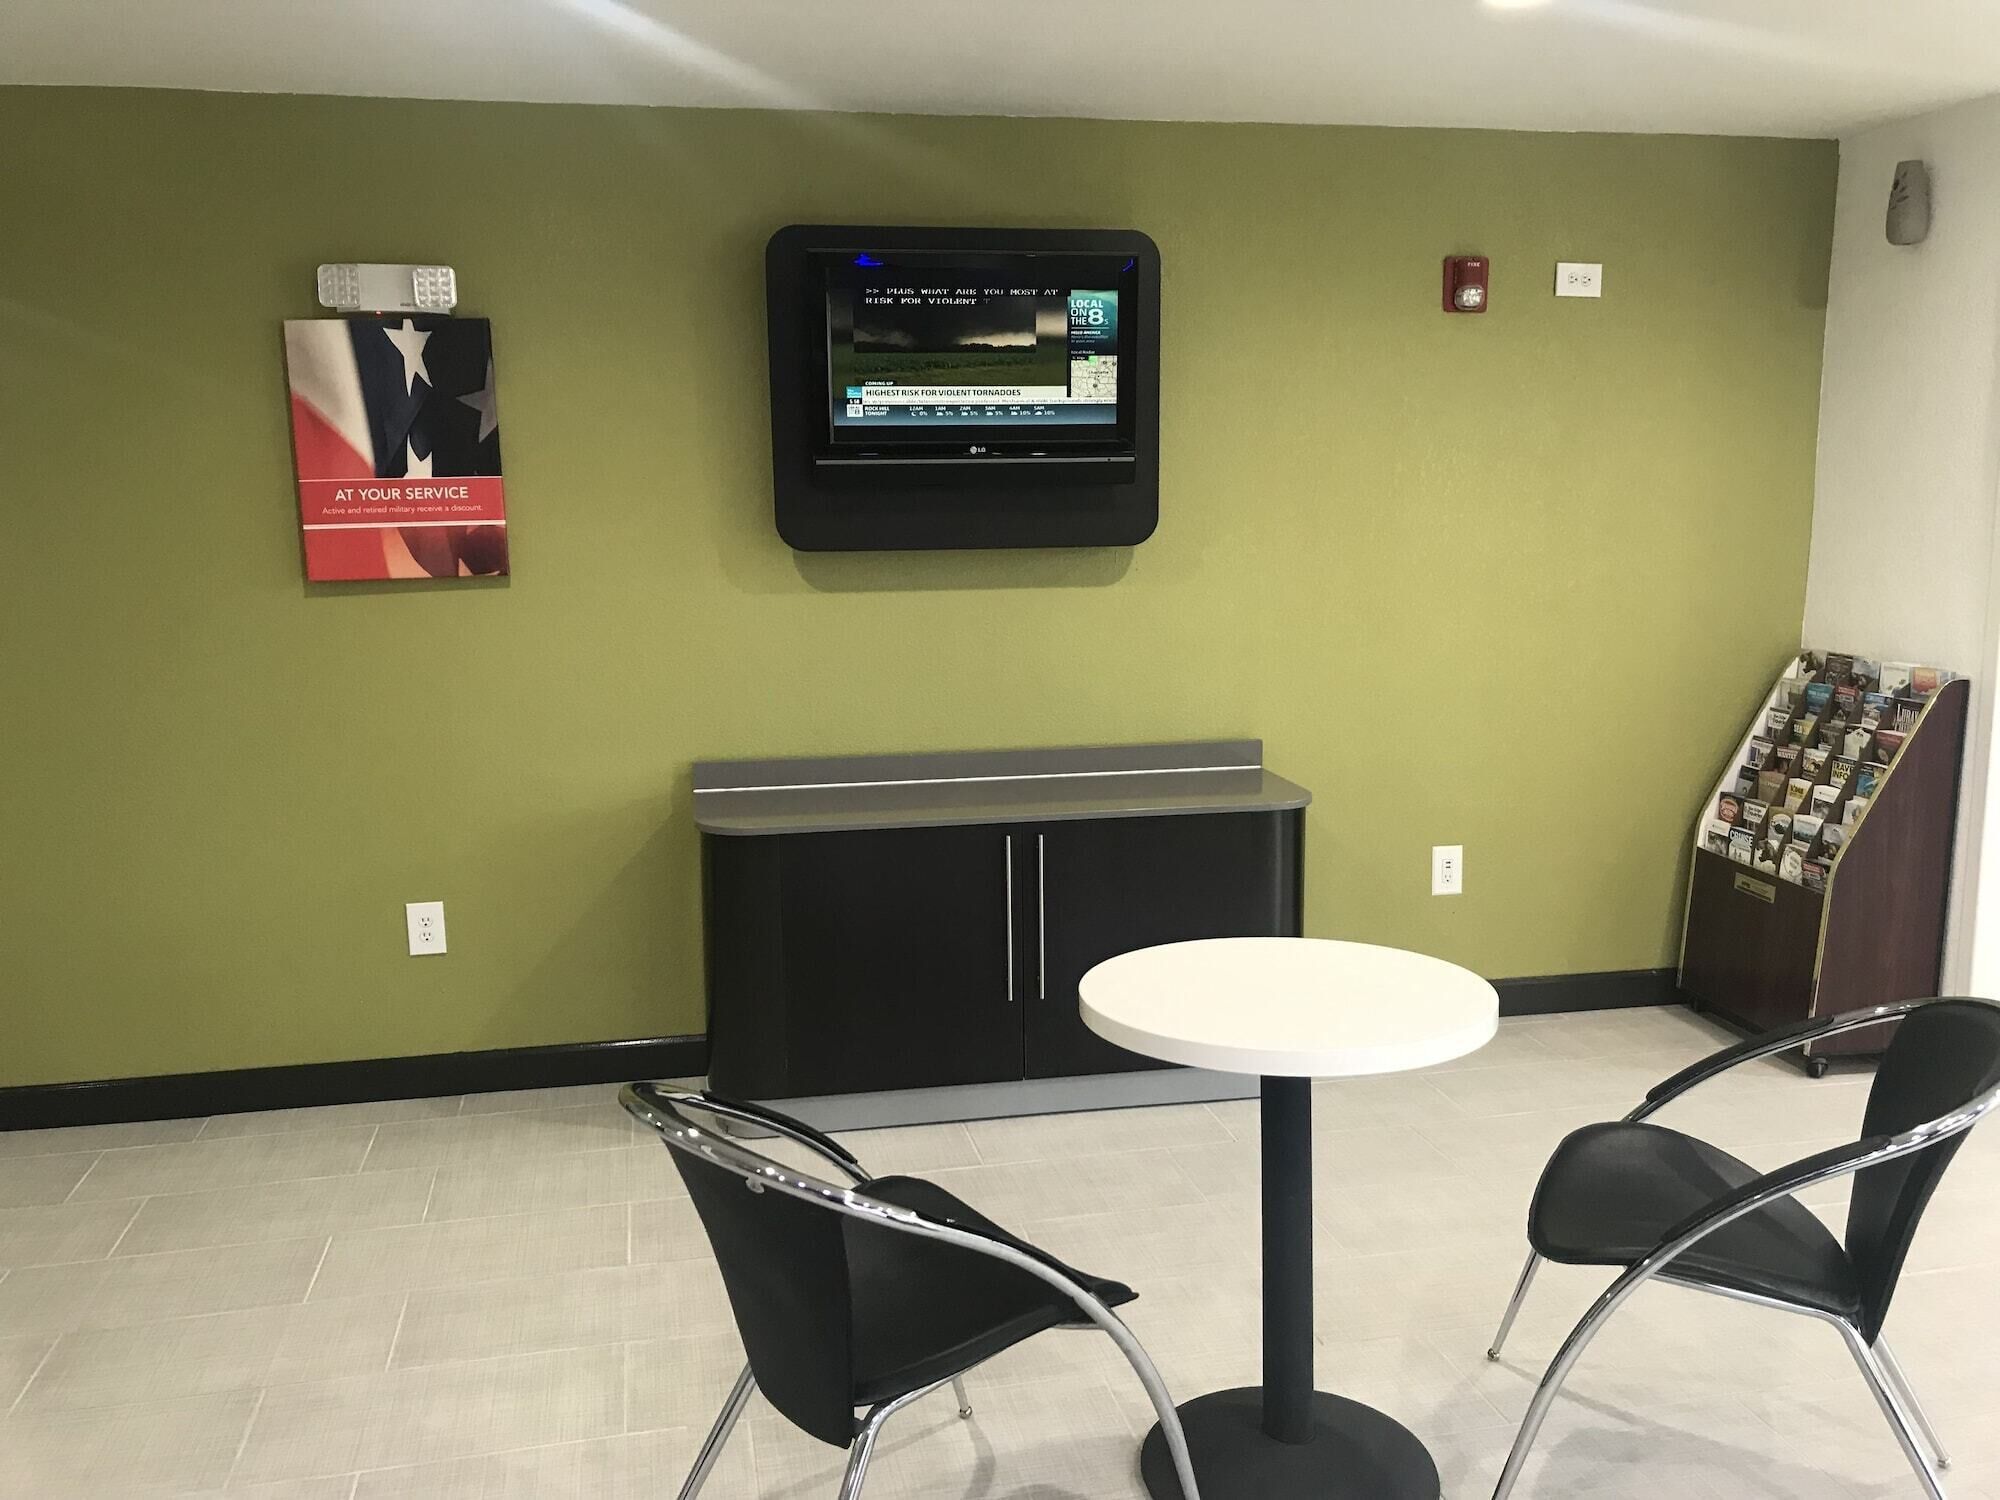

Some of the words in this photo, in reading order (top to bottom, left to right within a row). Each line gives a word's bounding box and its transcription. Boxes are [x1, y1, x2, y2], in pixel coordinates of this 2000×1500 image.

[886, 287, 915, 295] PLUS
[1070, 299, 1104, 308] LOCAL
[1070, 308, 1087, 316] ON
[1070, 316, 1087, 325] THE
[335, 489, 354, 502] AT
[358, 487, 401, 501] YOUR
[405, 486, 469, 500] SERVICE
[322, 507, 346, 515] Active
[347, 506, 361, 514] and
[363, 506, 387, 514] retired
[389, 505, 415, 514] military
[417, 505, 443, 513] receive
[451, 504, 483, 512] discount.
[1832, 770, 1849, 780] INFO
[1729, 829, 1754, 847] CRUISE
